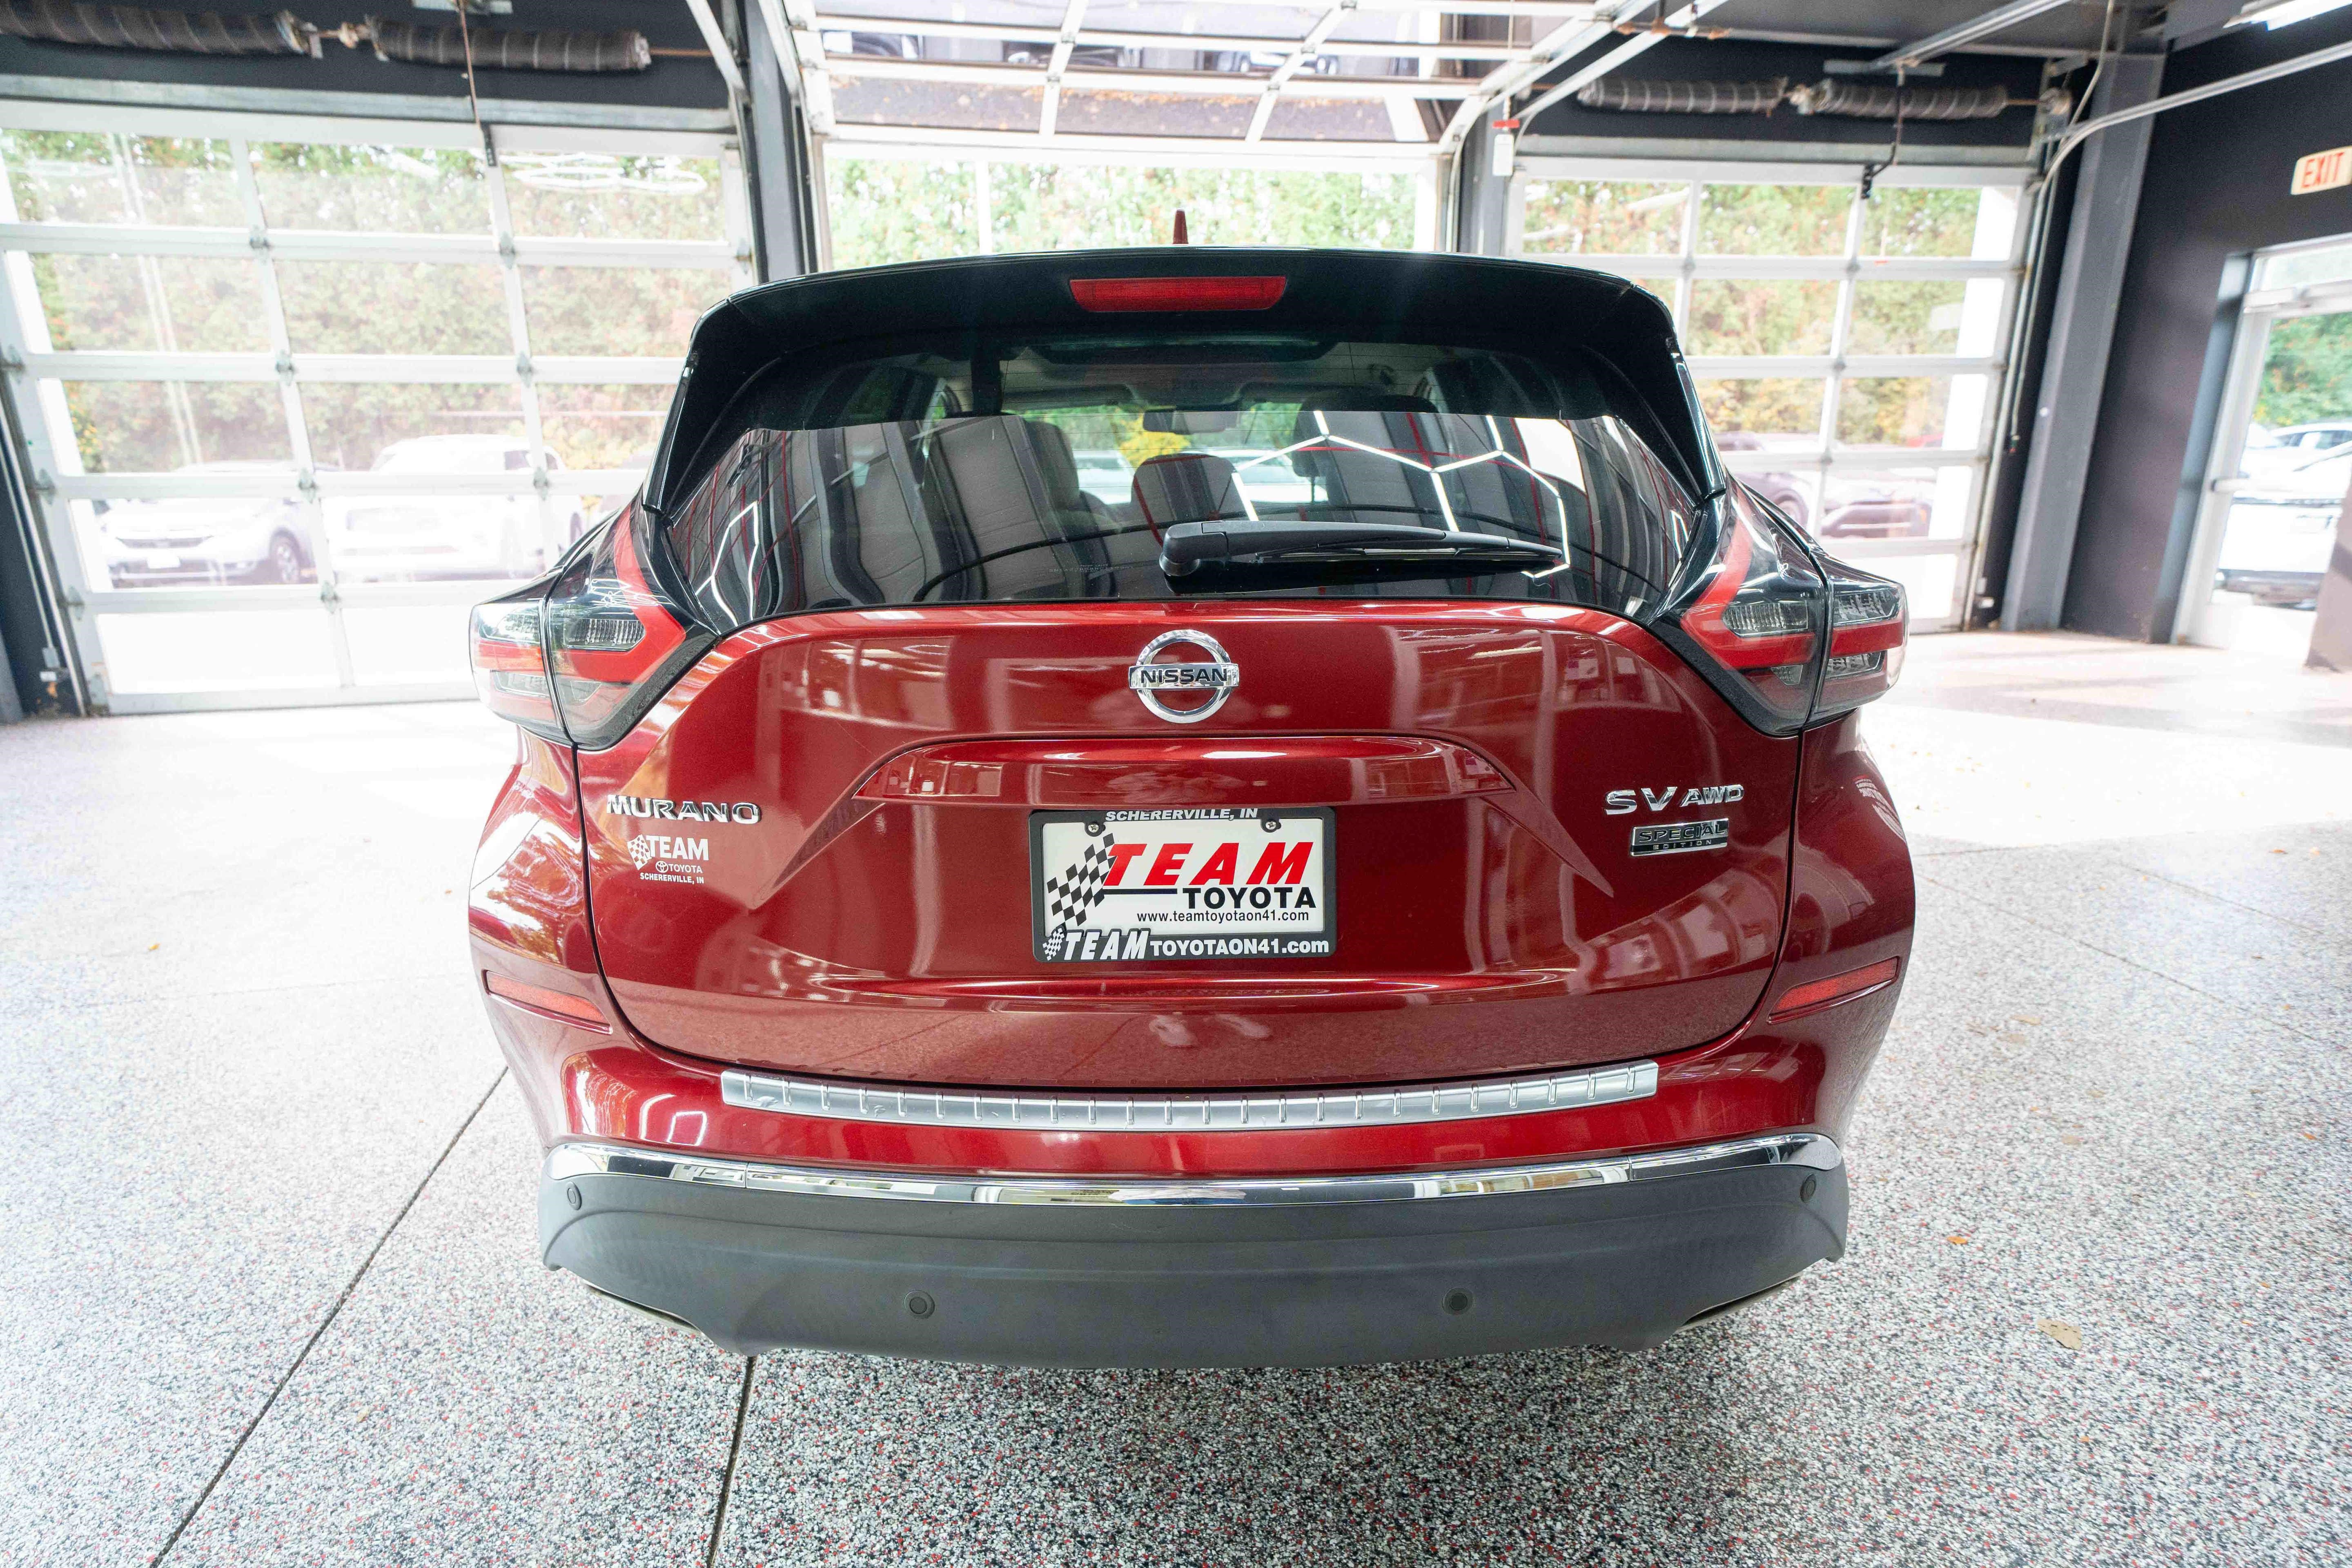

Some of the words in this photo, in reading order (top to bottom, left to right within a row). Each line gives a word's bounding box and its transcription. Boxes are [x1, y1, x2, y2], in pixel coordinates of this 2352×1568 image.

[2301, 152, 2345, 189] EXIT
[1140, 668, 1227, 684] NISSAN
[606, 794, 761, 824] MURANO
[1605, 786, 1677, 815] SV
[1679, 784, 1744, 807] AWD
[1105, 809, 1234, 821] SCHERERVILLE,
[1239, 808, 1258, 817] IN
[1639, 823, 1725, 842] SPECIAL
[646, 835, 709, 861] TEAM
[1653, 839, 1712, 851] EDITION
[668, 863, 703, 873] TOYOTA
[1102, 842, 1314, 886] TEAM
[640, 872, 694, 884] SCHERERVILLE,
[1183, 887, 1316, 909] TOYOTA
[1137, 910, 1309, 924] www.teamtoyotaon41.com
[1064, 931, 1149, 960] TEAM
[1150, 939, 1329, 956] TOYOTAON41.com
